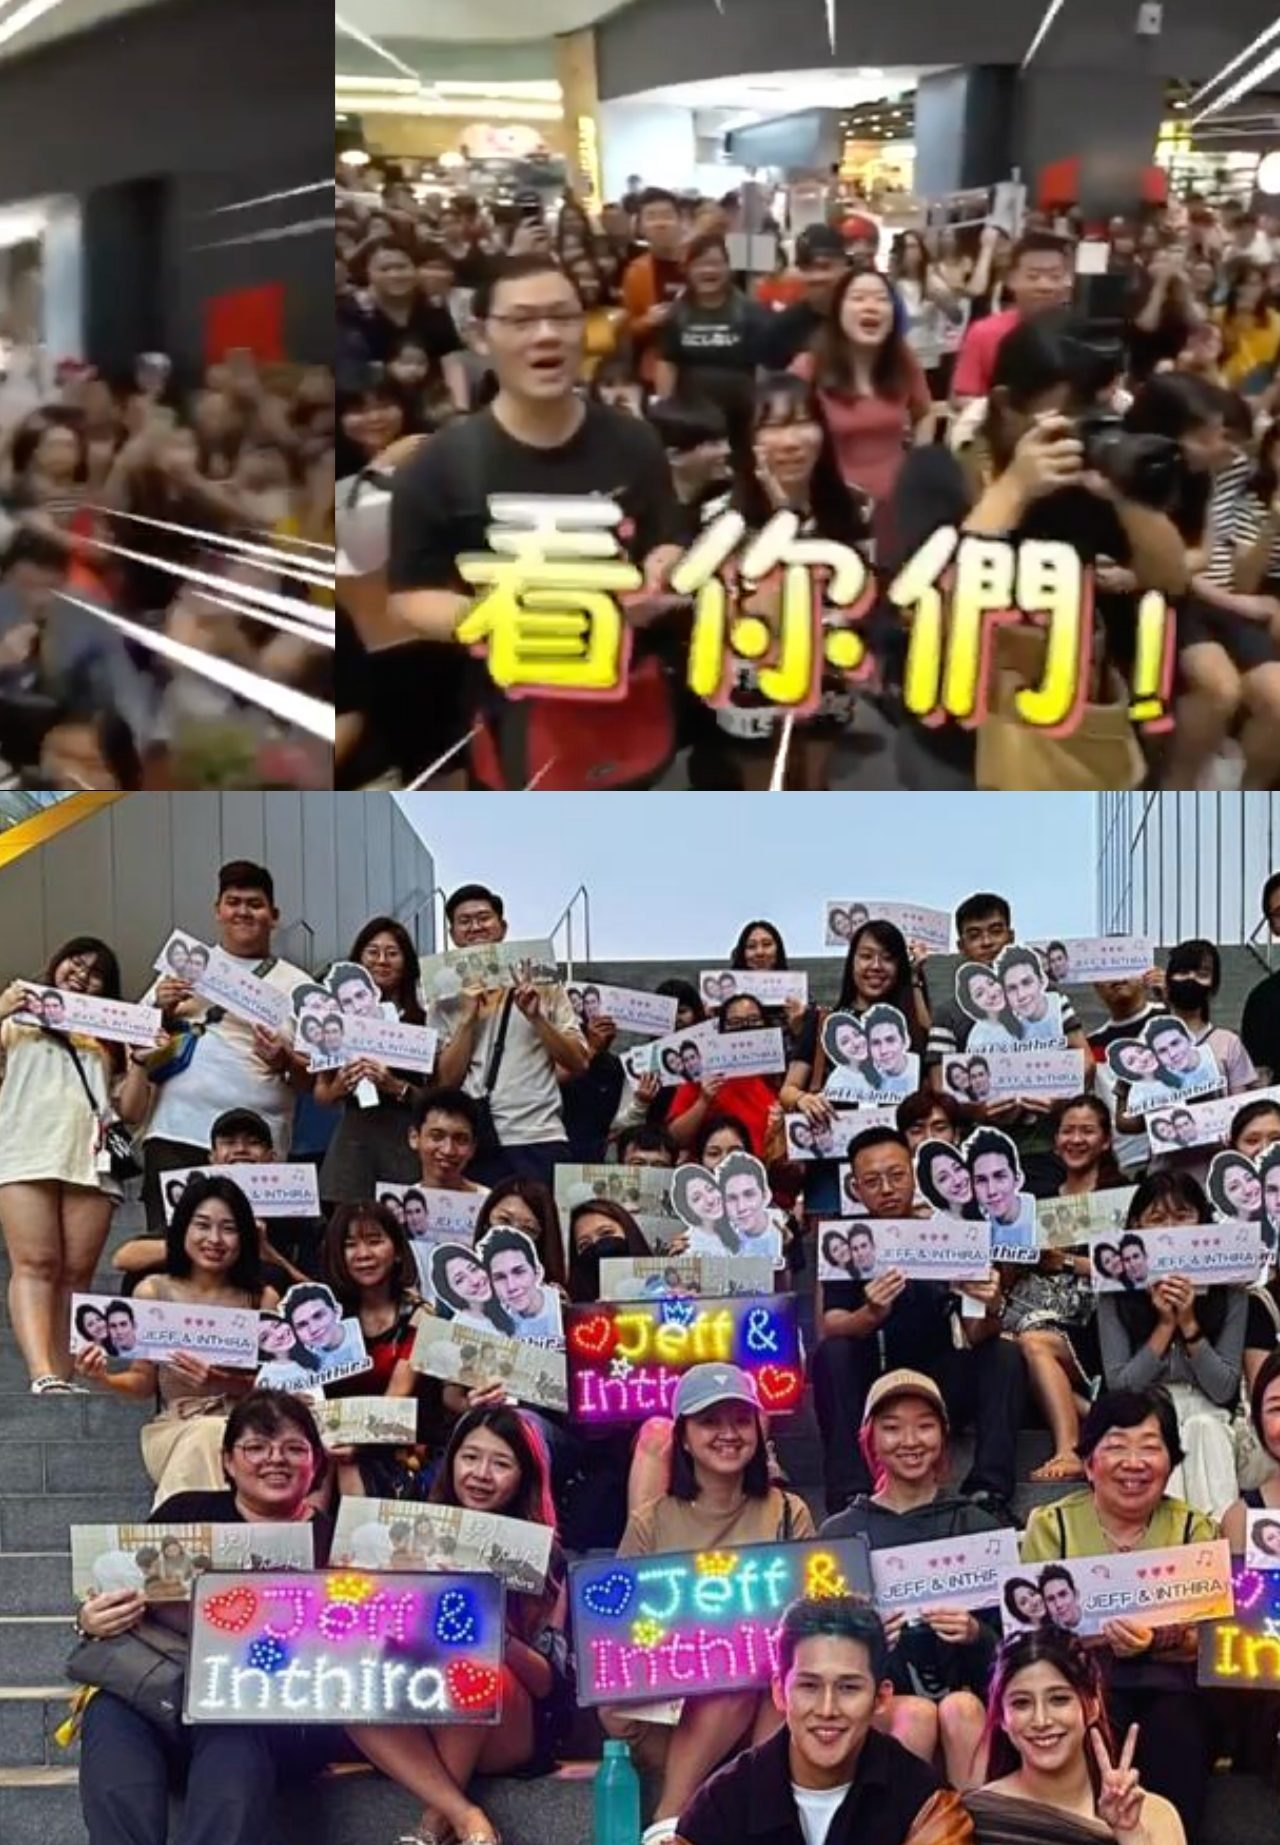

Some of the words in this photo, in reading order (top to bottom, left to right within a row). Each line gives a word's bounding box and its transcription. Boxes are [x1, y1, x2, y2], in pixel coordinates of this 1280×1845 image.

[614, 1311, 734, 1358] Jeff
[746, 1308, 778, 1352] &
[637, 1556, 791, 1620] Jeff
[805, 1552, 848, 1601] &
[882, 1579, 926, 1599] JEFF
[931, 1577, 944, 1592] &
[1085, 1591, 1133, 1610] JEFF
[1138, 1589, 1152, 1603] &
[1155, 1578, 1223, 1600] INTHIRA
[262, 1587, 418, 1641] Jeff
[437, 1590, 476, 1643] &
[201, 1654, 448, 1712] Inthira
